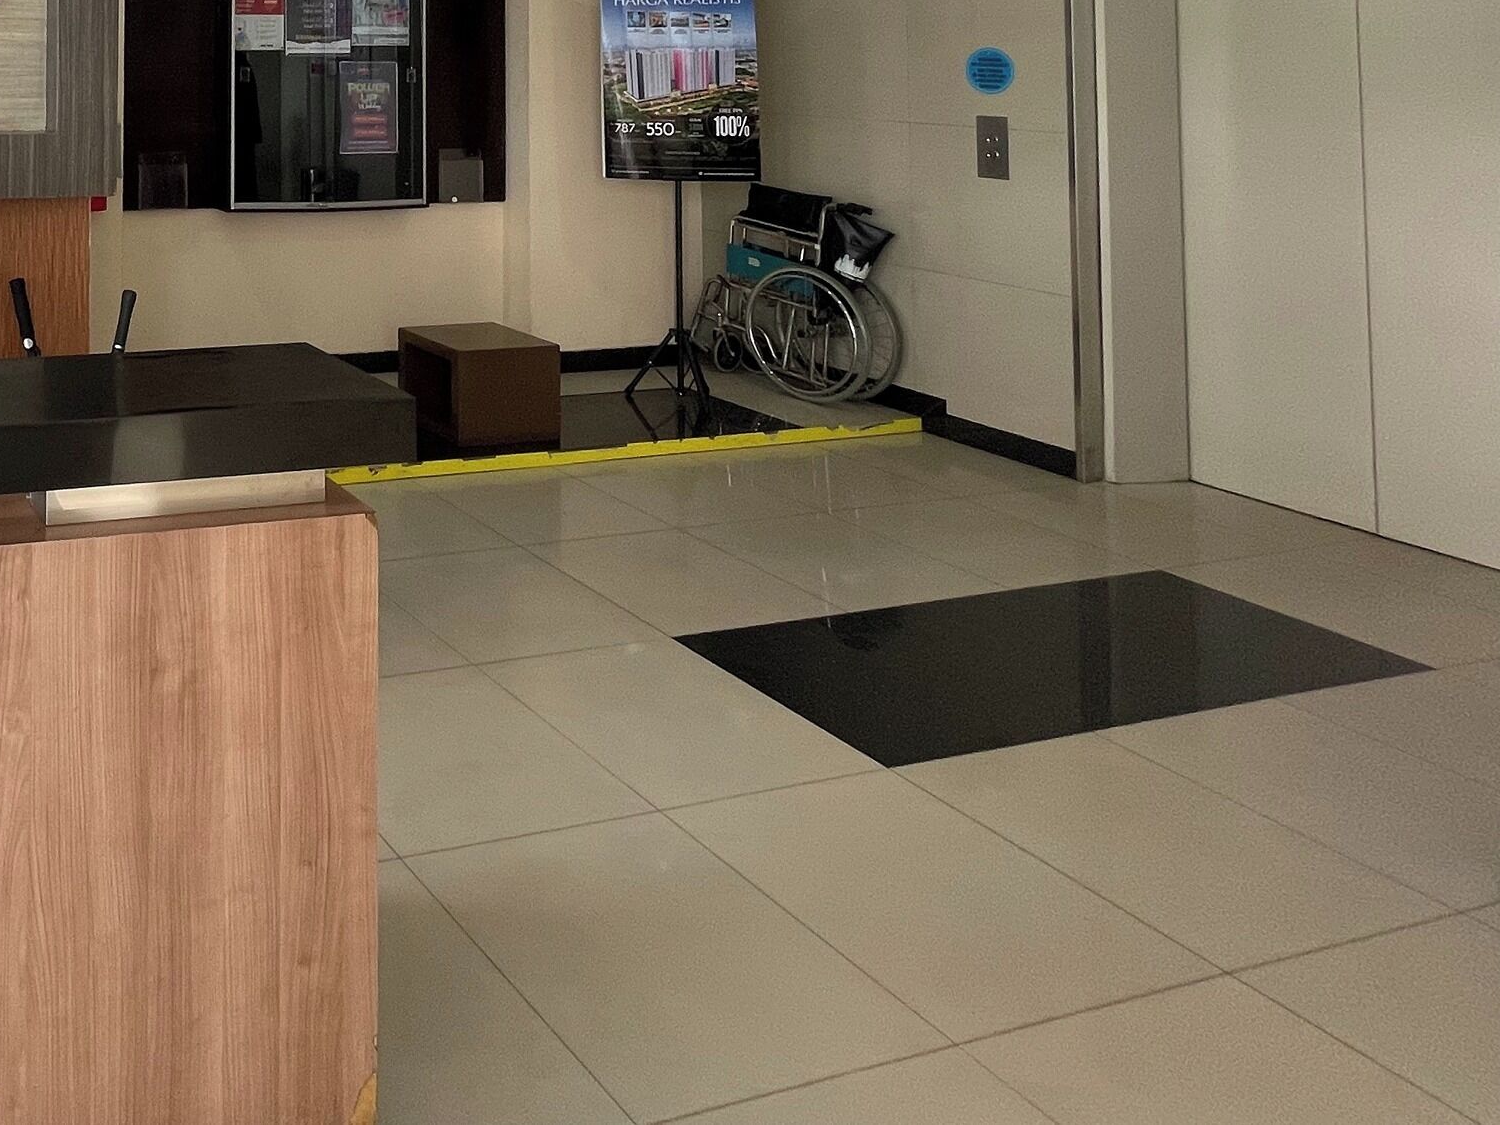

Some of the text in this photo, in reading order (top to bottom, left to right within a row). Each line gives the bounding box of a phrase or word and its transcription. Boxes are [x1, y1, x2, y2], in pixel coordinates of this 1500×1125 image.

[614, 123, 636, 133] 787
[646, 122, 675, 136] 550
[713, 115, 750, 137] 100%
